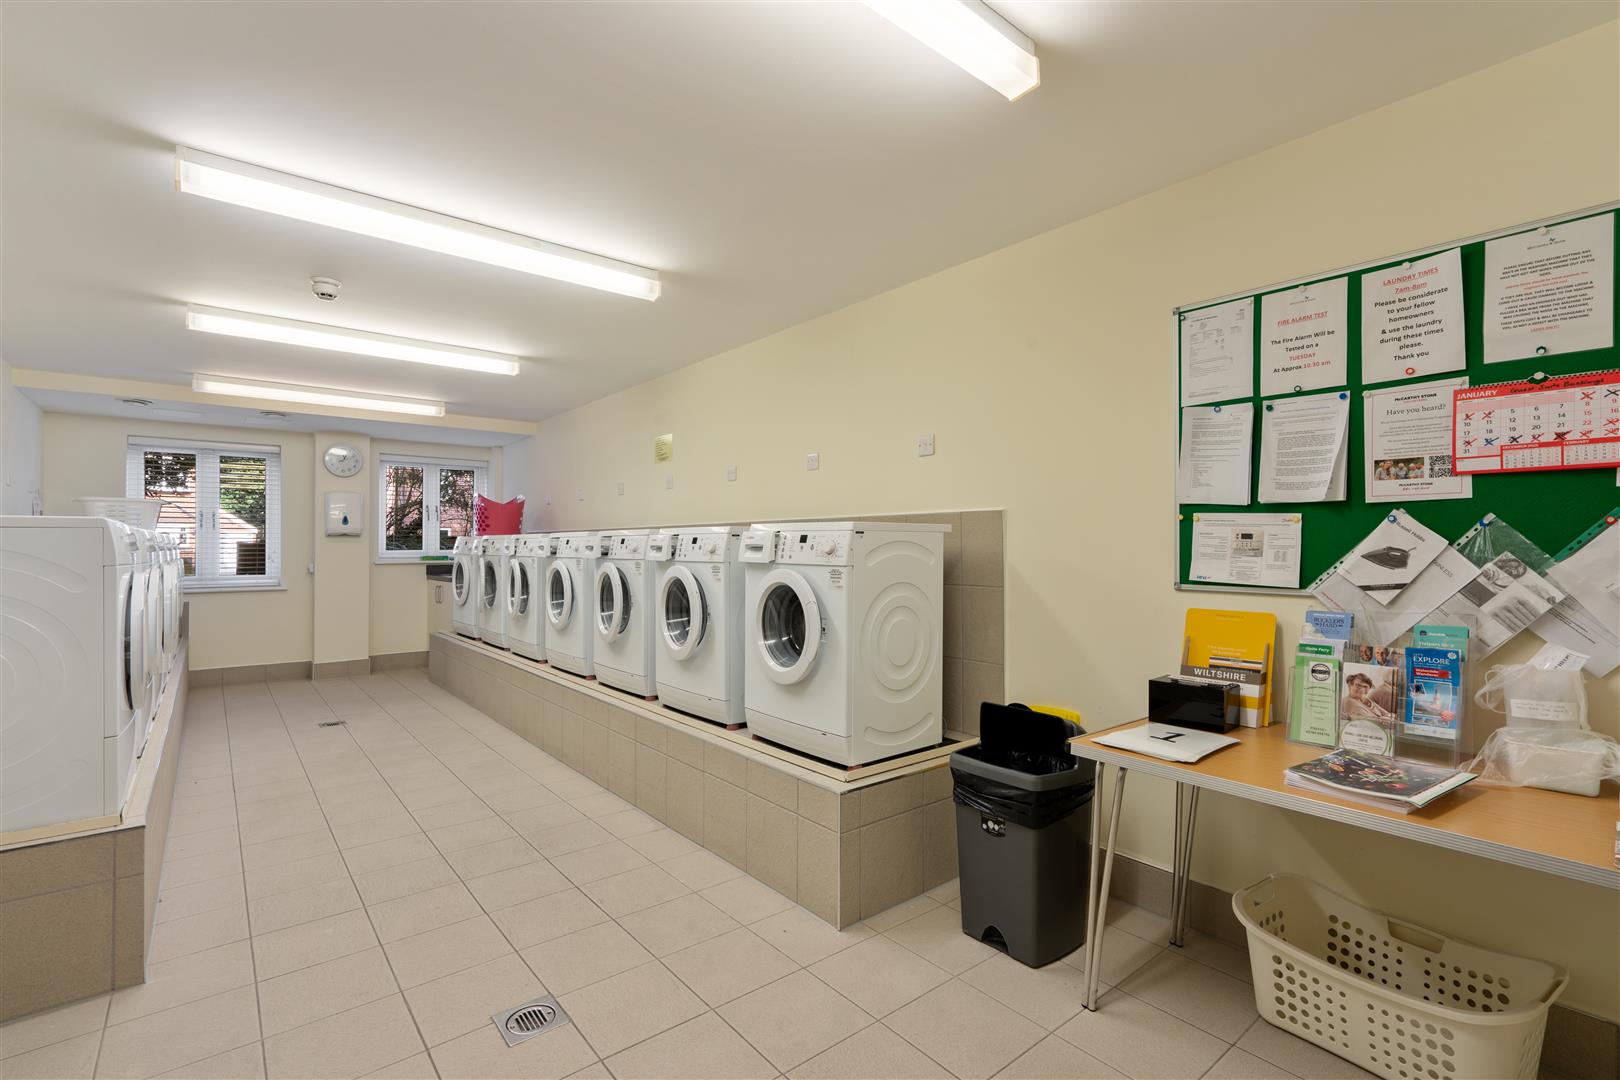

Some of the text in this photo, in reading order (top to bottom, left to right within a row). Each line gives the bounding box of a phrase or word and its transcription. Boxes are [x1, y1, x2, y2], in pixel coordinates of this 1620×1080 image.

[1383, 266, 1439, 286] LAUNDRY TIMES
[1394, 282, 1428, 294] 7am-8pm
[1374, 299, 1396, 308] Please
[1408, 287, 1448, 301] considerate
[1396, 305, 1412, 313] your
[1414, 300, 1436, 309] fellow
[1277, 310, 1328, 328] FIRE ALARM TEST
[1388, 310, 1435, 324] homeowners
[1416, 318, 1443, 329] laundry
[1379, 328, 1445, 344] during these times
[1285, 344, 1305, 352] Tested
[1399, 342, 1424, 351] please.
[1289, 352, 1316, 362] TUESDAY
[1393, 352, 1415, 361] Thank
[1281, 364, 1302, 372] Approx
[1457, 390, 1498, 400] JANUARY
[1406, 407, 1420, 415] you
[1421, 404, 1446, 412] heard?
[1413, 656, 1450, 665] EXPLORE
[1194, 668, 1247, 681] WILTSHIRE
